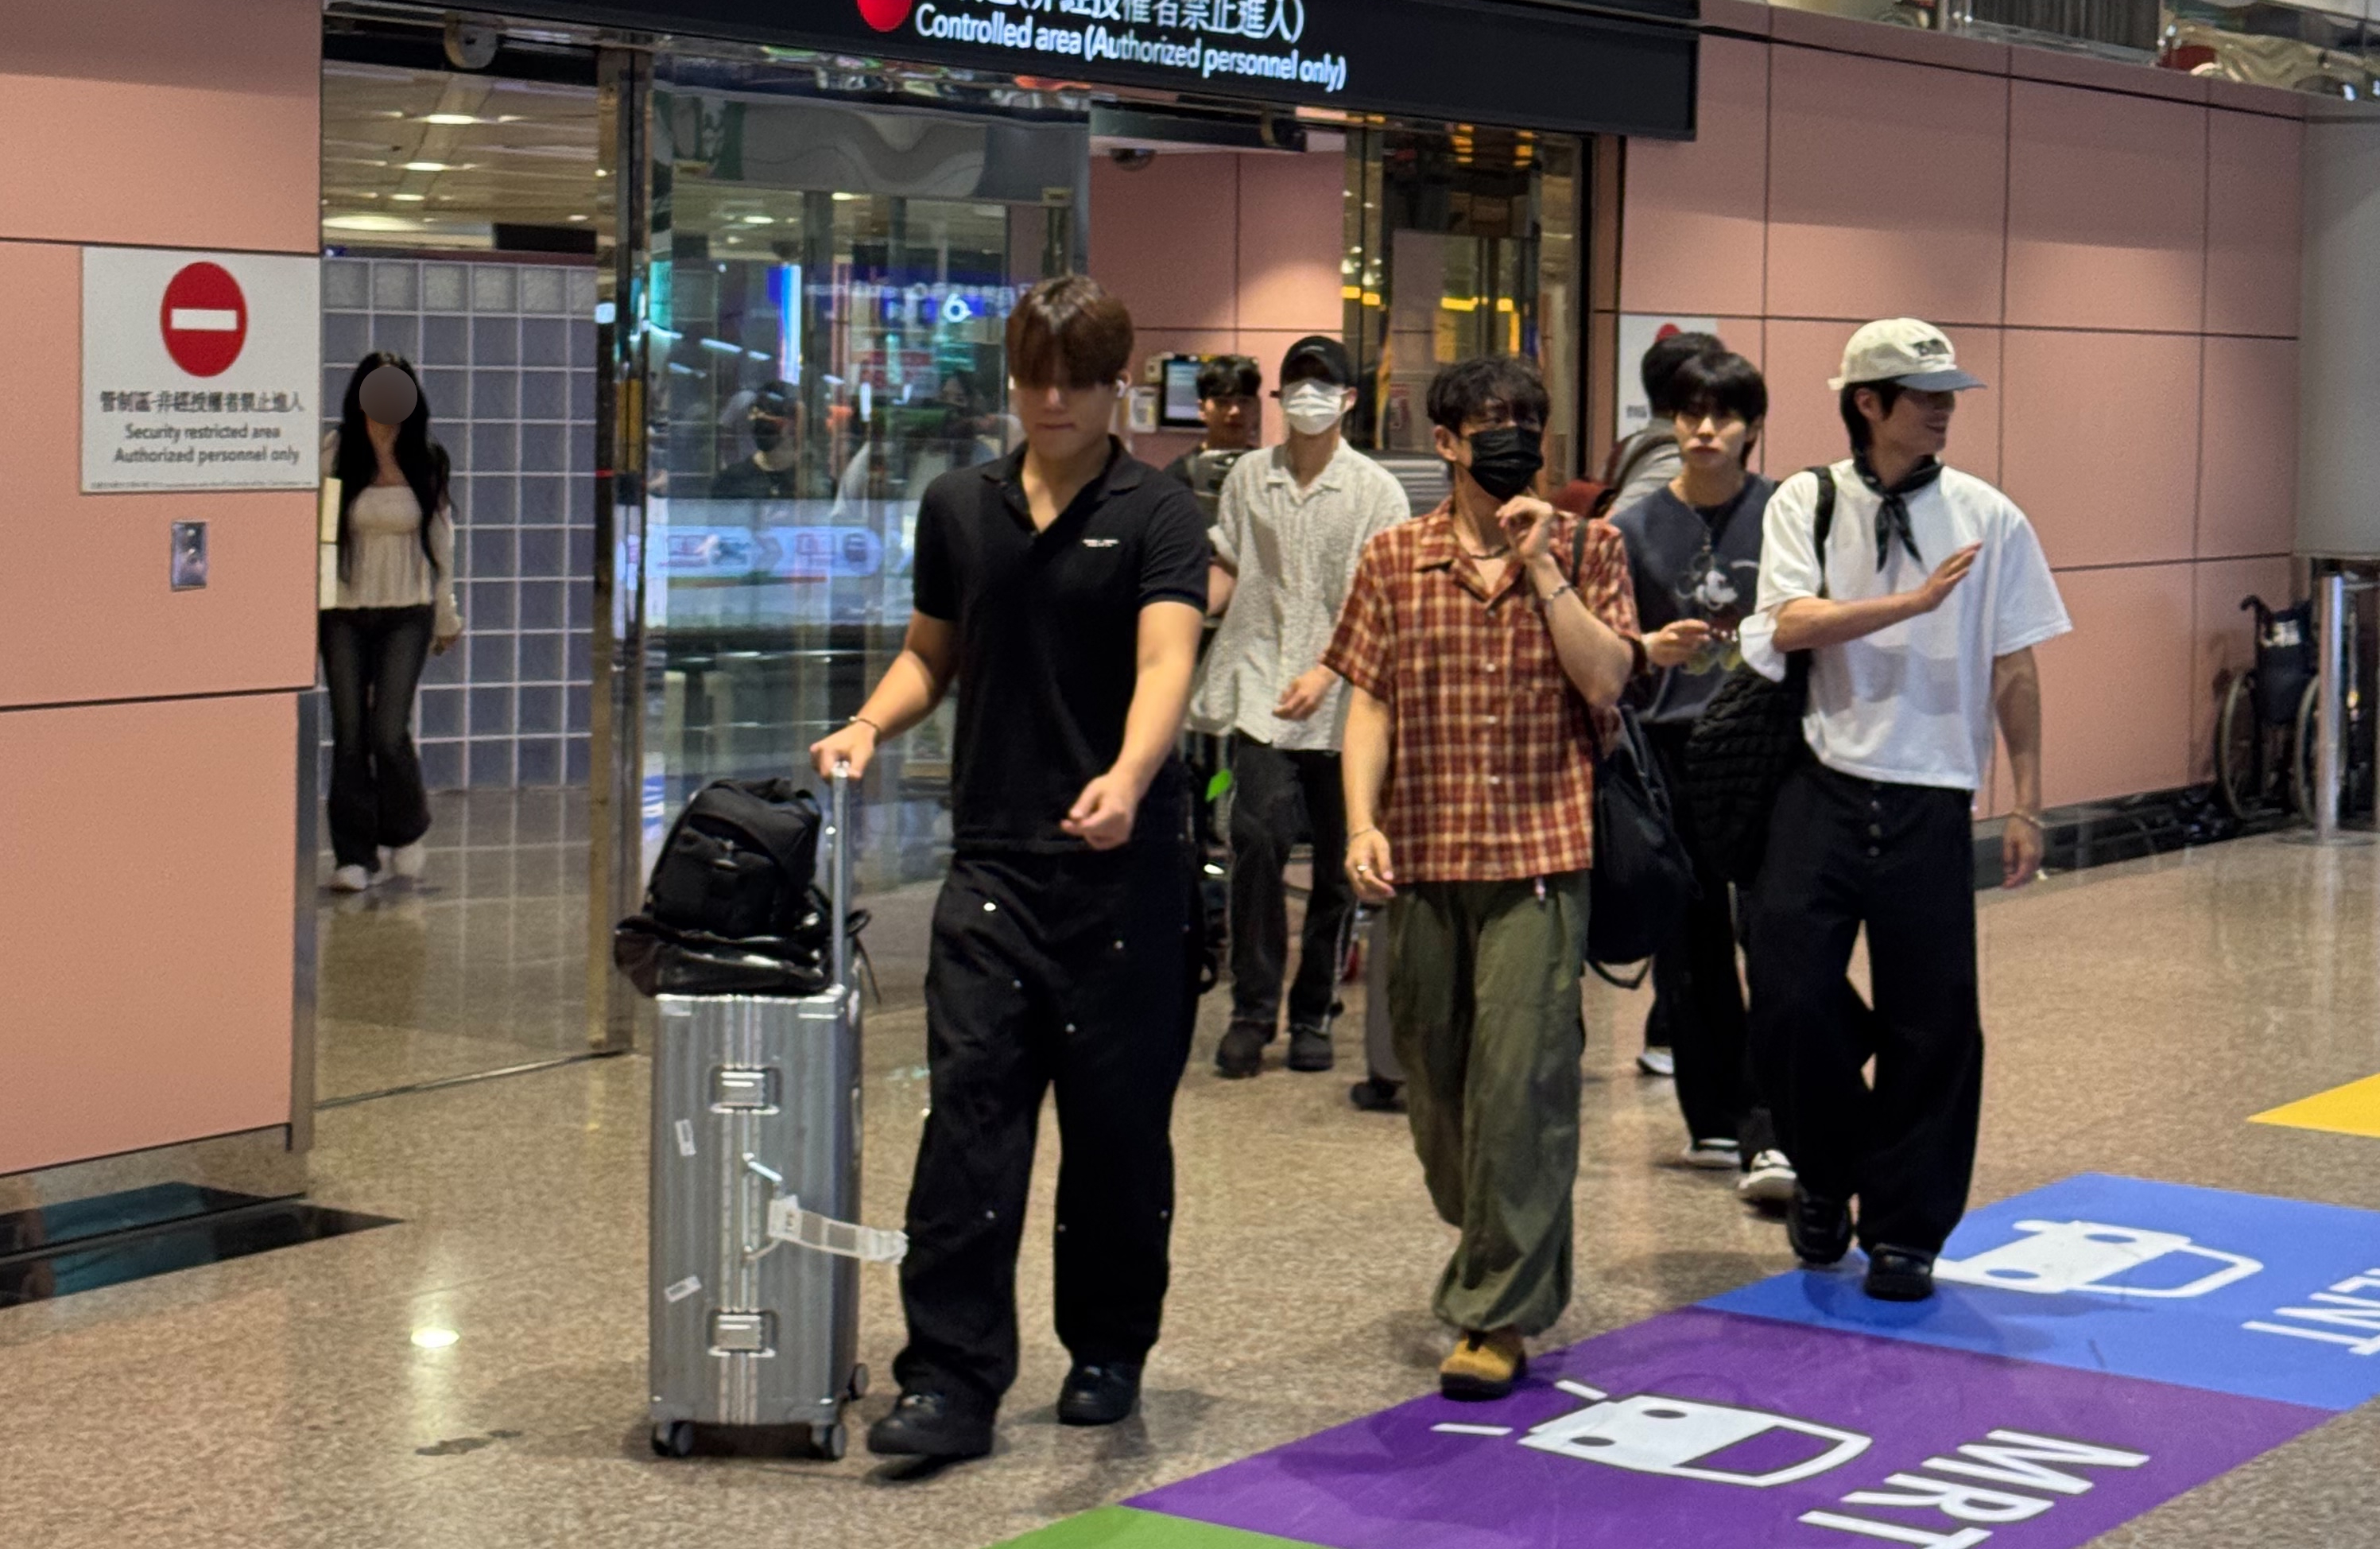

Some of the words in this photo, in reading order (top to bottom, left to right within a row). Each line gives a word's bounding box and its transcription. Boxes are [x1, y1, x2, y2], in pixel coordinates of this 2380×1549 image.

[915, 3, 1033, 49] Controlled
[1035, 26, 1081, 55] area
[1084, 23, 1201, 69] (Authorized
[1202, 49, 1299, 79] personnel
[1300, 52, 1346, 93] only)
[114, 446, 194, 462] Authorized
[199, 445, 267, 466] personnel
[271, 445, 299, 465] only
[125, 423, 180, 444] Security
[184, 423, 248, 438] restricted
[252, 427, 280, 438] area
[1797, 1429, 2150, 1549] MRT
